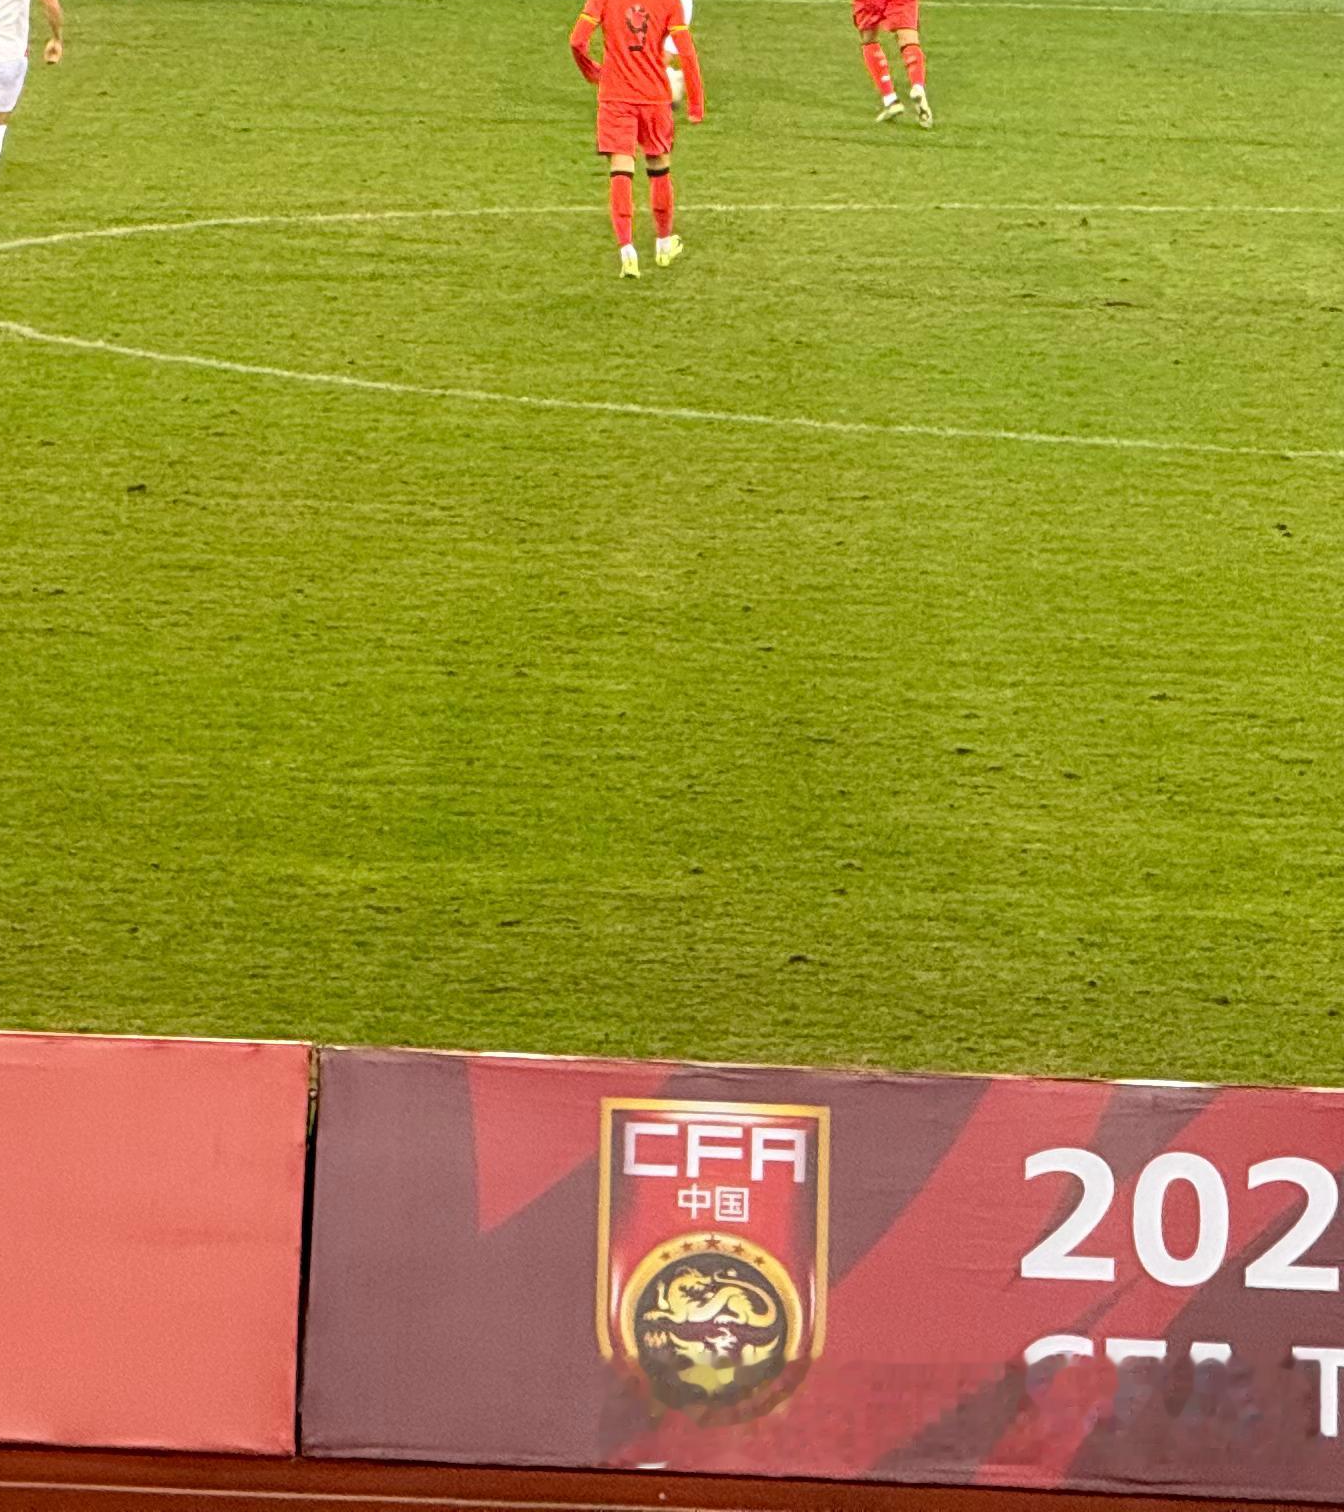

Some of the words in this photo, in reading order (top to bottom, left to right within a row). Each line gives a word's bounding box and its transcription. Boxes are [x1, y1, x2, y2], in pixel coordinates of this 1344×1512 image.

[623, 1121, 807, 1184] CFA
[677, 1182, 750, 1223] 中国
[1020, 1146, 1340, 1293] 202
